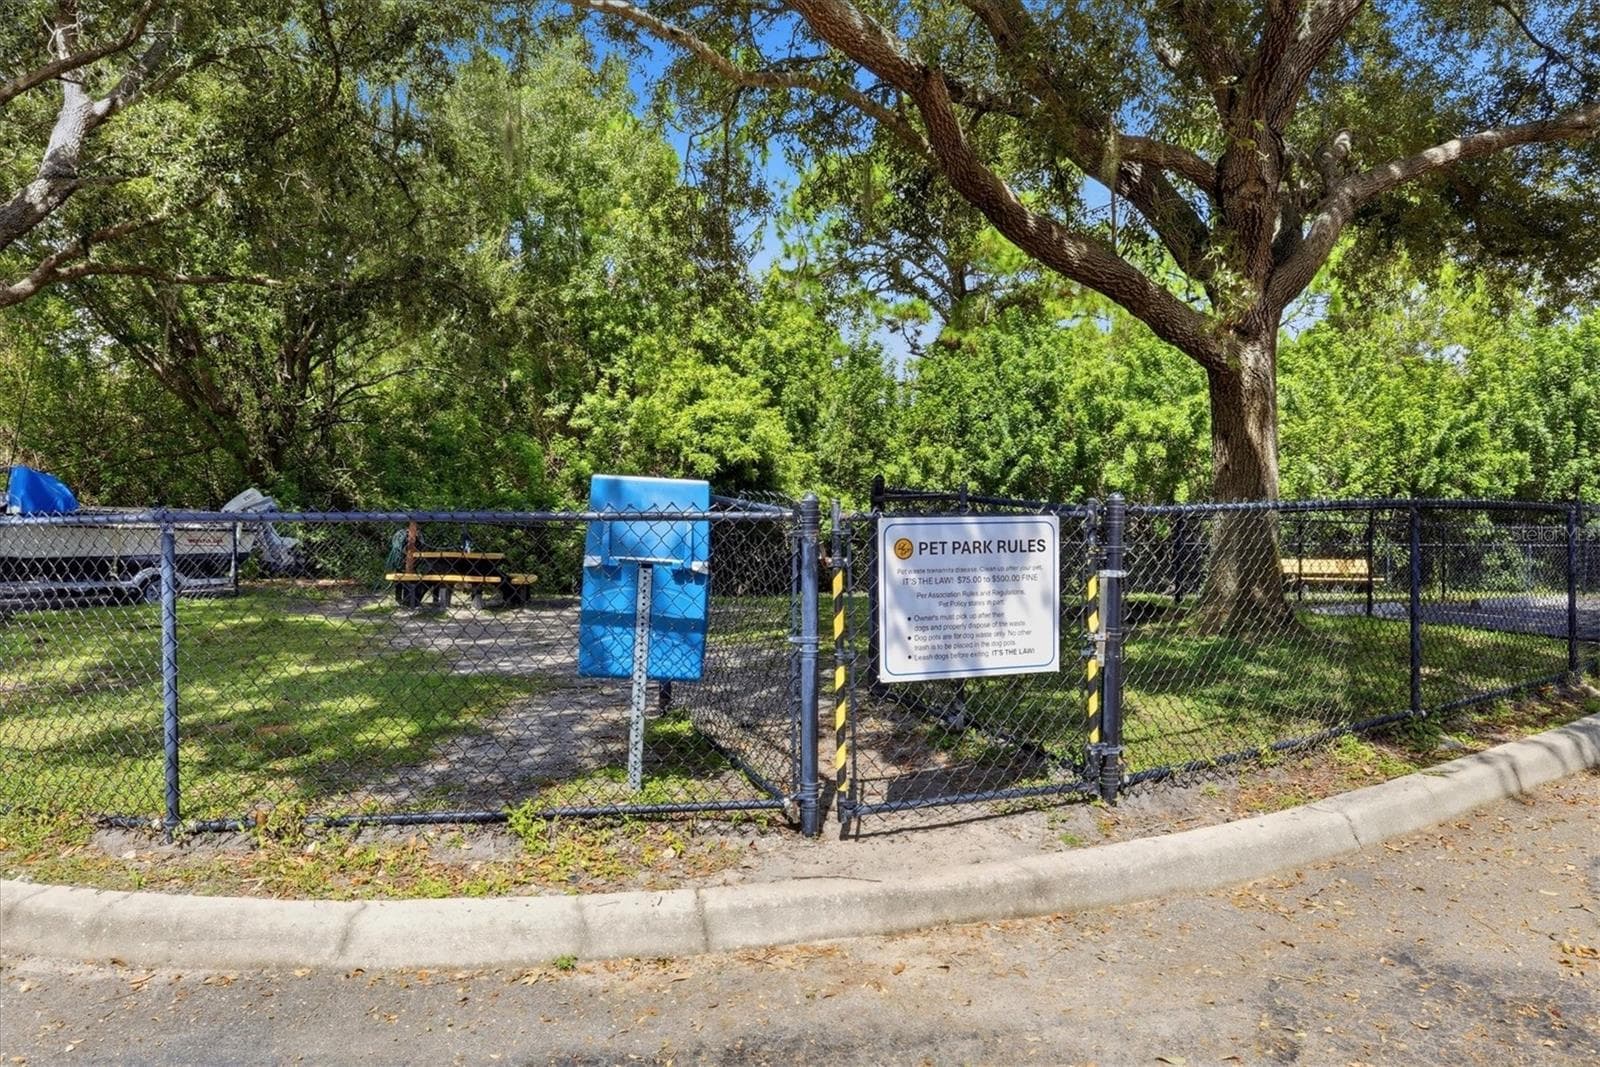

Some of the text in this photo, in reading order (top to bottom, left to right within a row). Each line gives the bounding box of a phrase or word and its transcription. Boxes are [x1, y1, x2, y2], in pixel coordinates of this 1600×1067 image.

[919, 539, 1046, 555] PET PARK RULES
[935, 576, 954, 584] LAW!
[957, 576, 982, 584] $75.00
[992, 574, 1020, 582] $500.00
[914, 614, 938, 622] Owner's
[956, 613, 968, 622] pick
[942, 623, 967, 632] properly
[968, 622, 990, 630] dispose
[962, 633, 974, 641] dog
[934, 654, 949, 662] dogs
[1018, 648, 1036, 656] LAW!
